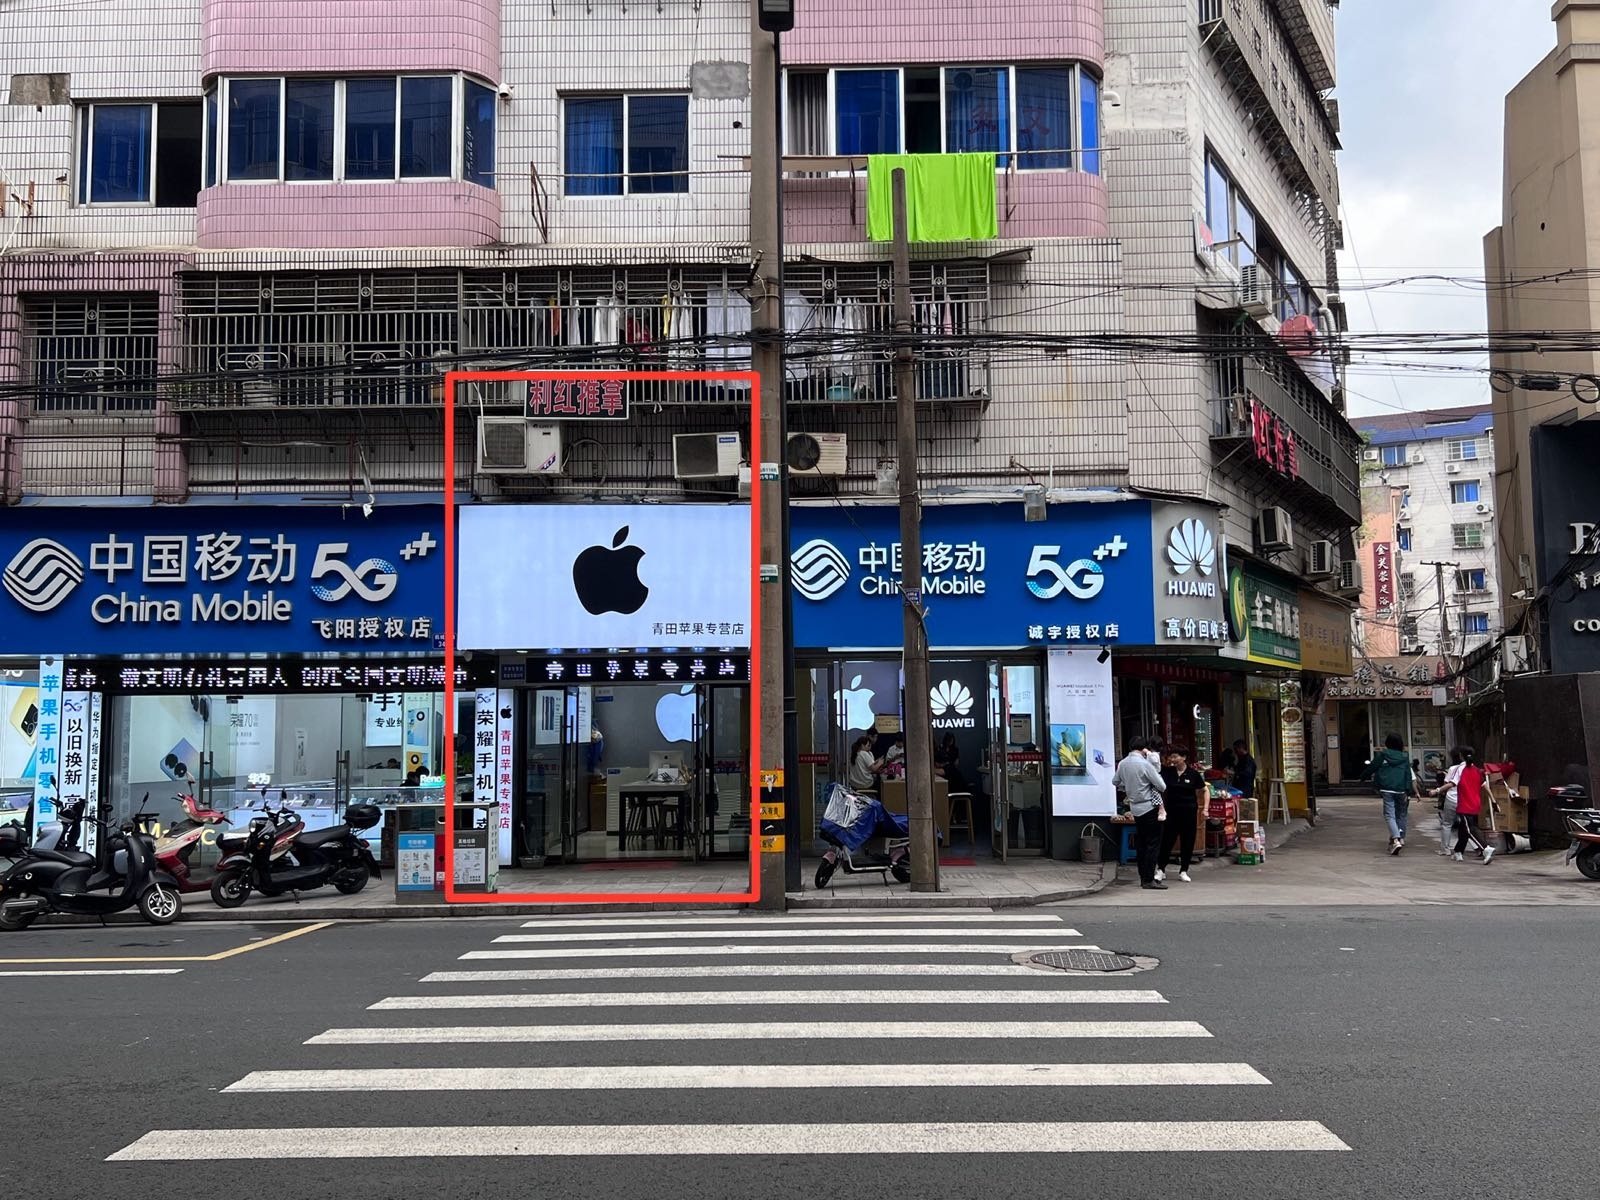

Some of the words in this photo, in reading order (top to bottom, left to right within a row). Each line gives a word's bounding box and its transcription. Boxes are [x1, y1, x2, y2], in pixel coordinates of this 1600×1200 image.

[90, 532, 296, 584] 中国移动
[921, 575, 986, 594] Mobile
[1168, 580, 1216, 597] HUAWEI
[91, 592, 181, 624] China
[191, 590, 292, 622] Mobile
[311, 617, 431, 638] 飞阳授权店
[652, 622, 744, 635] 青田苹果专营店
[1028, 623, 1119, 640] 诚宇授权店
[36, 675, 61, 829] 苹果手机零售
[64, 718, 84, 785] 以旧换新
[499, 729, 512, 829] 青田苹果专营店
